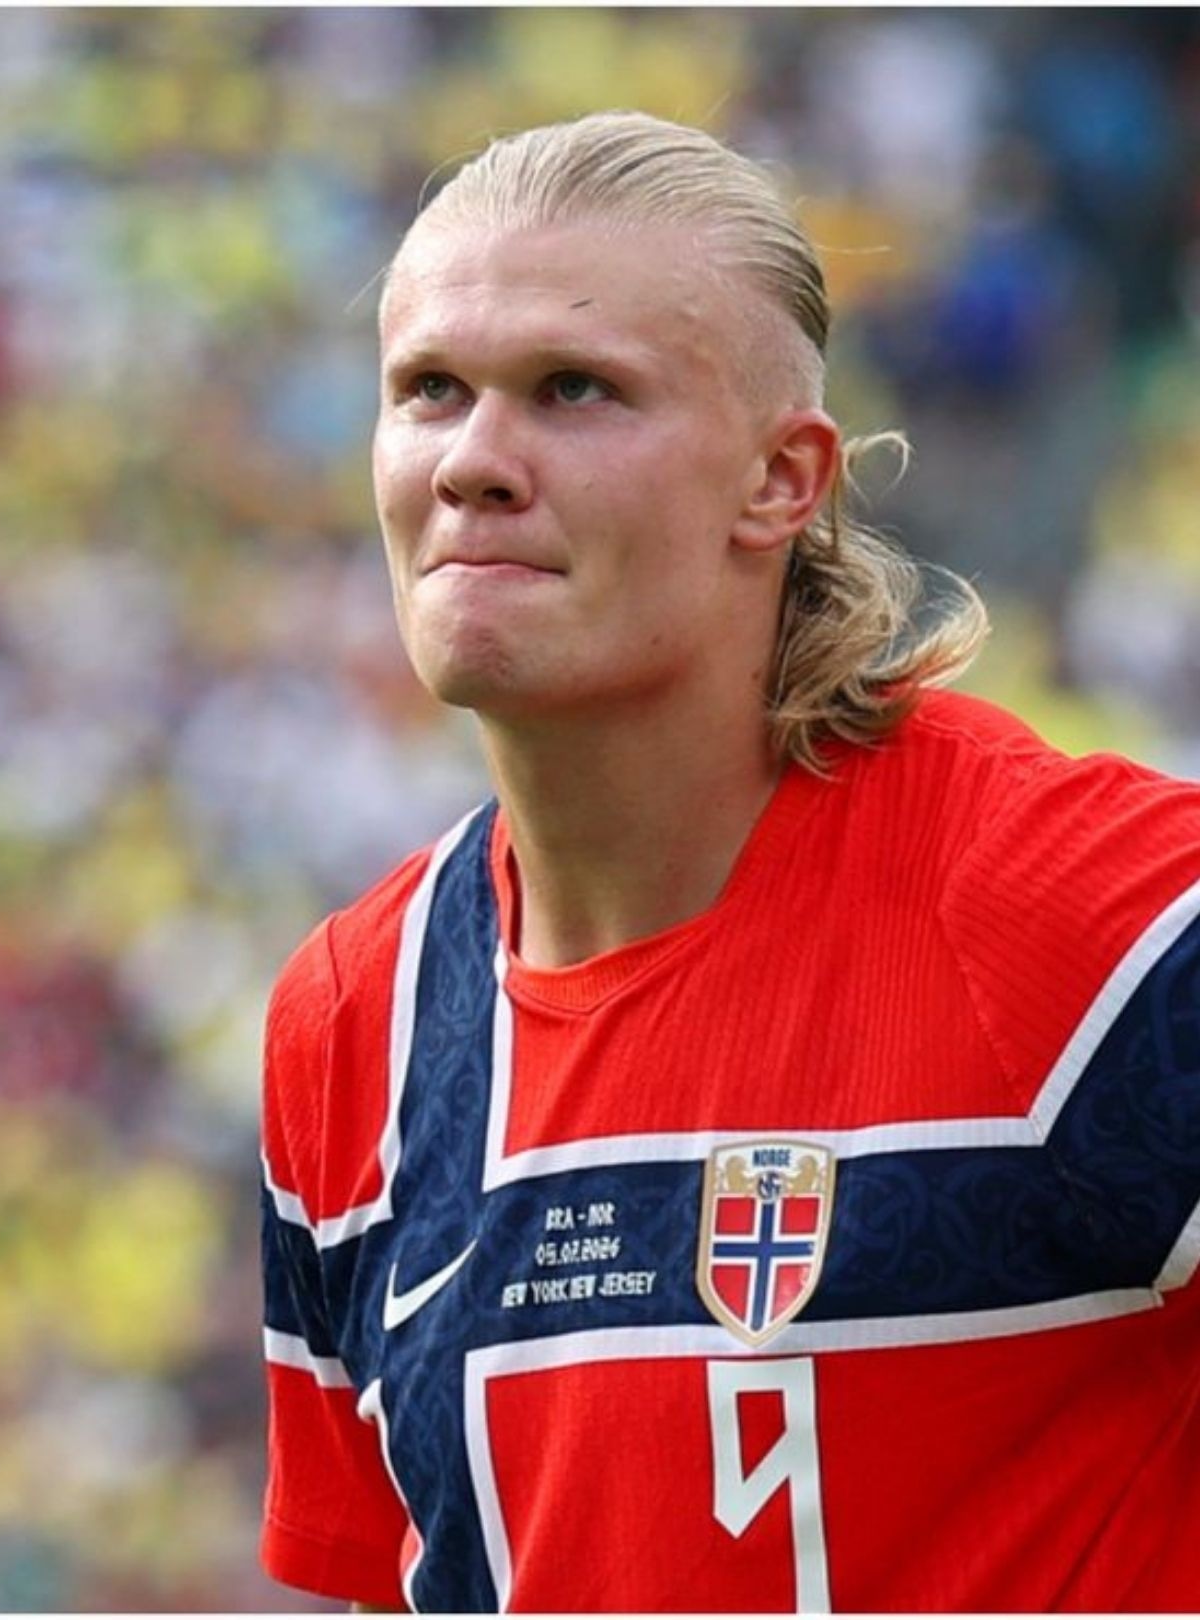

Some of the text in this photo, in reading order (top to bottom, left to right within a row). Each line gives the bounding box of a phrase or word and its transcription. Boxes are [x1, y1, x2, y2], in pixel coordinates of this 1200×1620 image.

[753, 1149, 791, 1167] NORGE
[531, 1278, 569, 1304] YORK
[598, 1271, 657, 1297] JERSEY
[707, 1356, 831, 1613] 9
